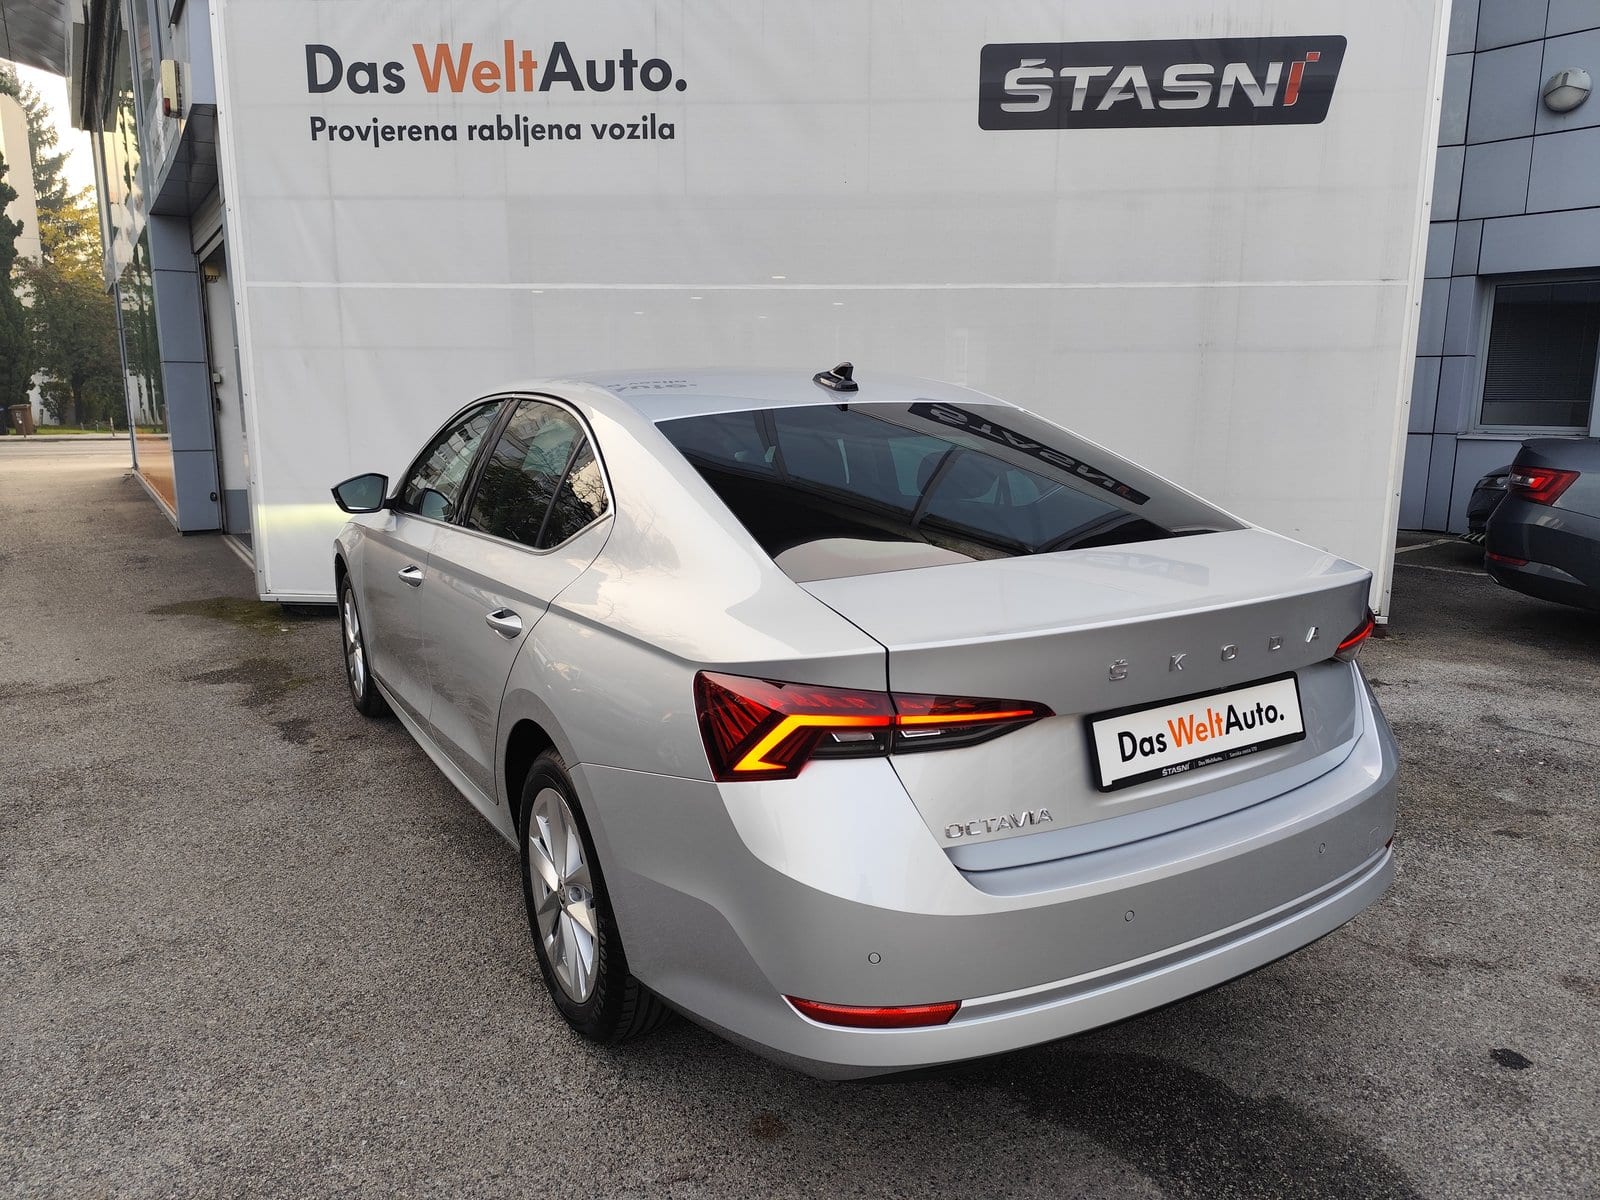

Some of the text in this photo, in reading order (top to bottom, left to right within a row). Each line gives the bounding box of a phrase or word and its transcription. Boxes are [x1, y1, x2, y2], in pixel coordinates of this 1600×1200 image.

[305, 39, 688, 94] Das WeltAuto.
[309, 112, 676, 147] Provjerena rabljena vozila
[1109, 625, 1320, 682] ŠKODA
[1117, 701, 1285, 763] Das WeltAuto.
[944, 807, 1054, 839] OCTAVIA
